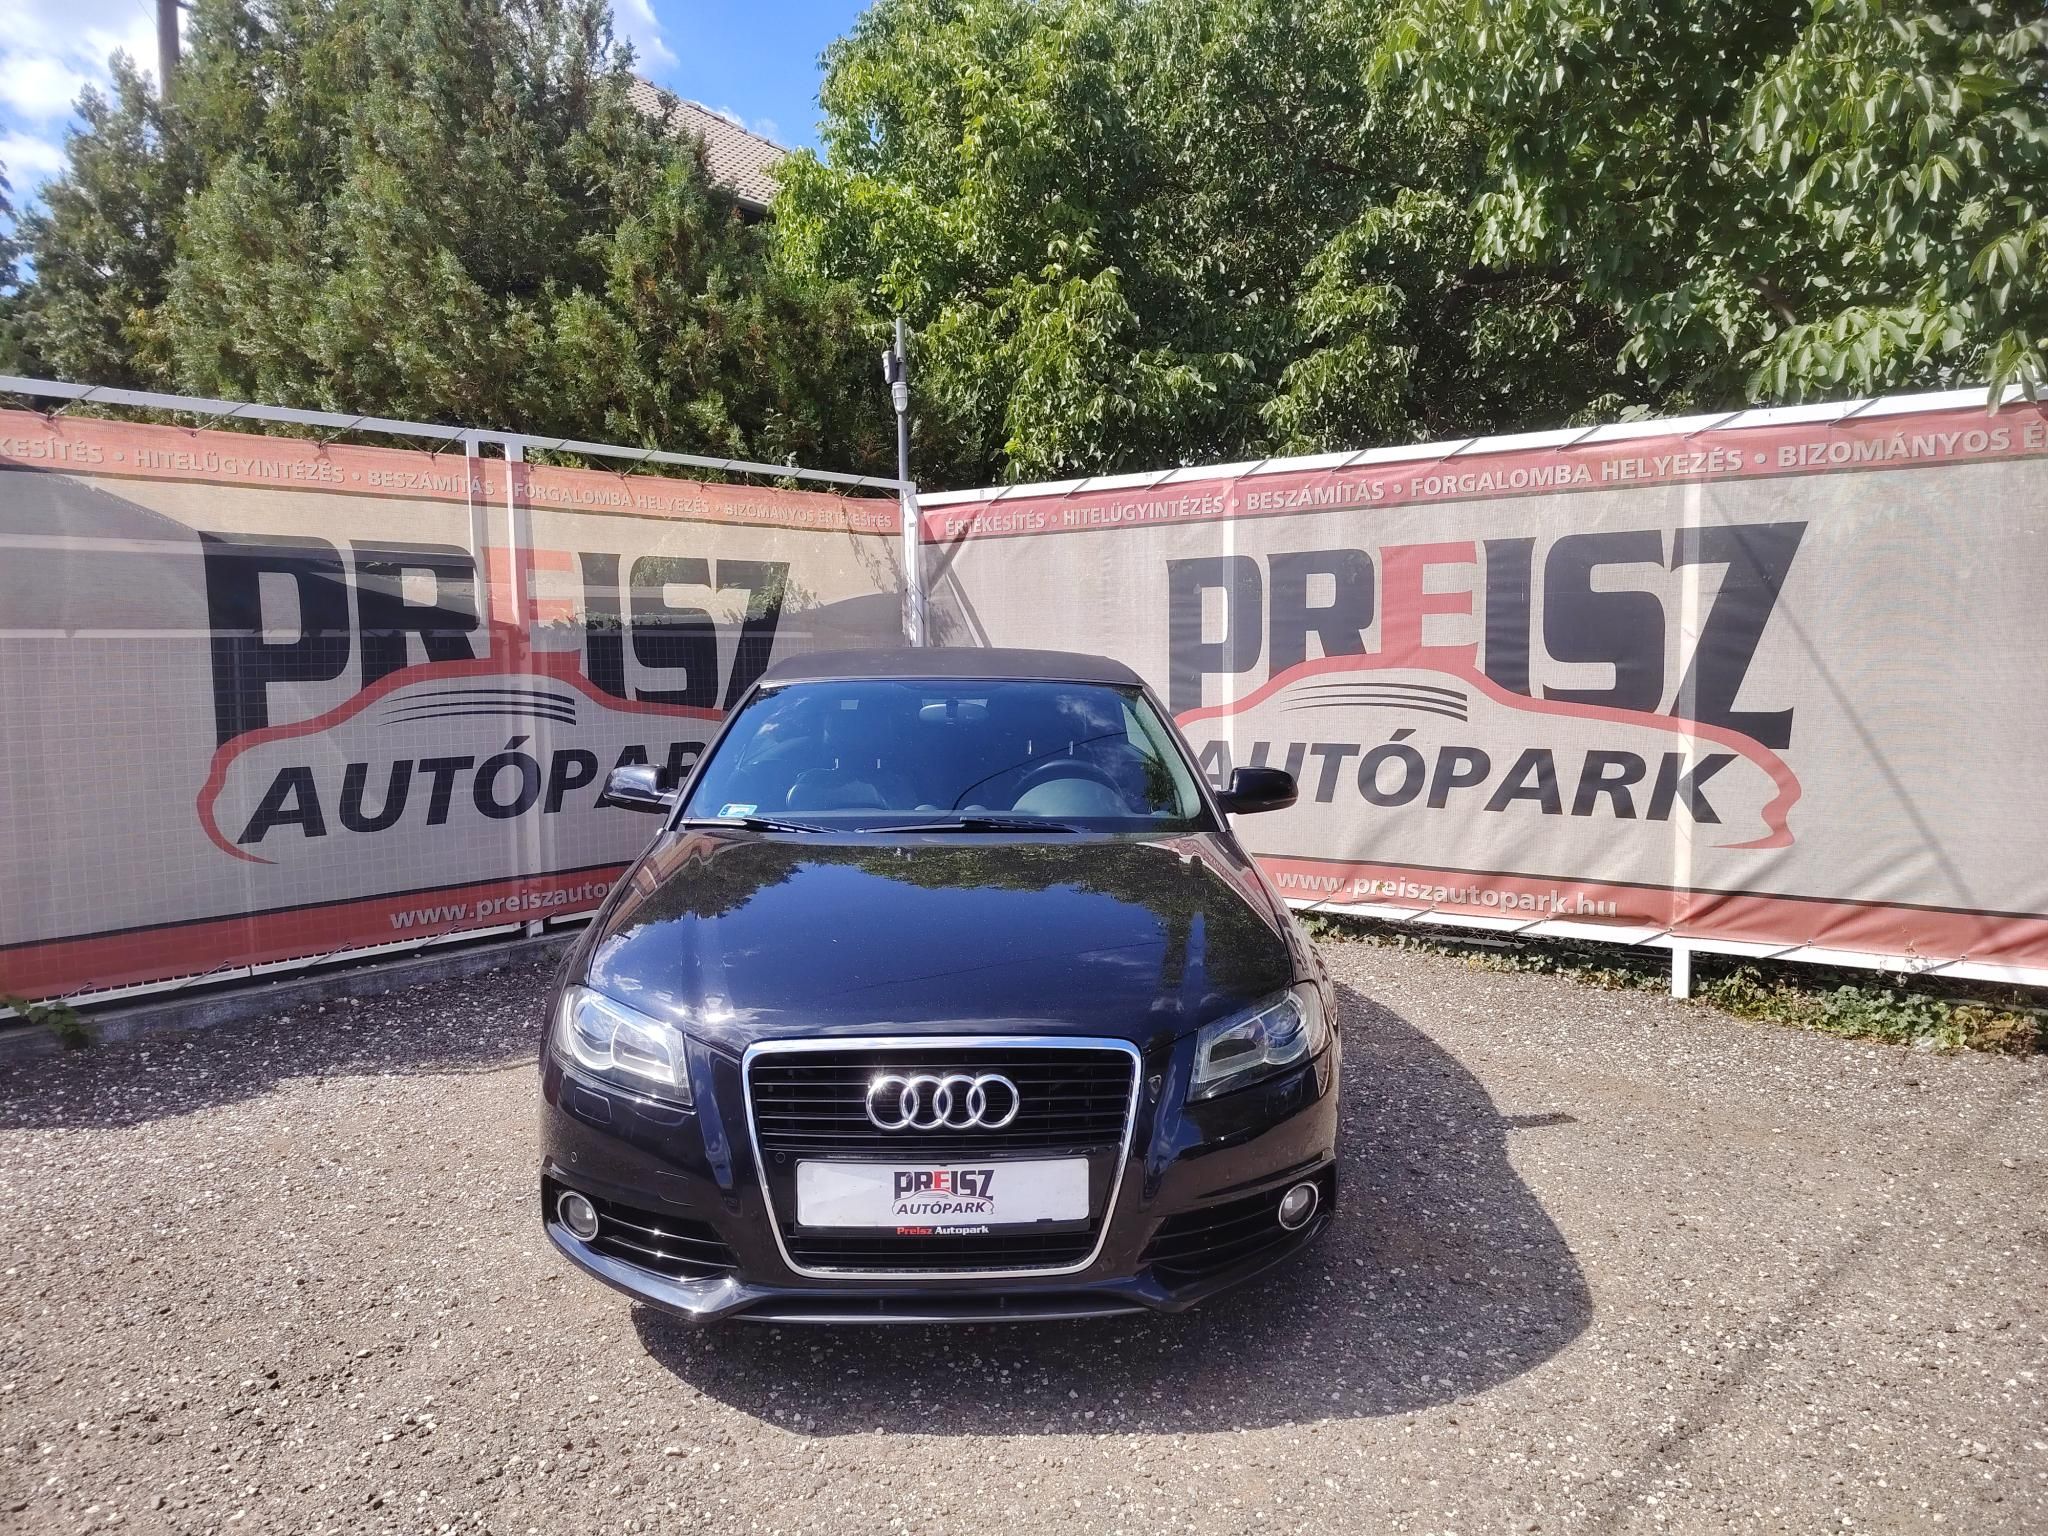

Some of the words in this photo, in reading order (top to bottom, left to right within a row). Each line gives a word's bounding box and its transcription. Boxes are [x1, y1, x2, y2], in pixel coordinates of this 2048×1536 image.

[134, 448, 345, 484] HITELÜGYINTÉZÉS
[368, 470, 495, 496] BESZÁMÍTÁS
[514, 482, 634, 507] FORGALOMBA
[637, 495, 710, 514] HELYEZÉS
[724, 503, 814, 522] BIZOMÁNYOS
[945, 511, 1046, 537] ÉRTÉKESÍTÉS
[1063, 494, 1225, 526] HITELÜGYINTÉZÉS
[1247, 480, 1385, 511] BESZÁMÍTÁS
[1411, 463, 1593, 497] FORGALOMBA
[1601, 446, 1744, 481] HELYEZÉS
[1777, 426, 2012, 468] BIZOMÁNYOS
[200, 531, 790, 747] PREISZ
[1166, 521, 1808, 749] PREISZ
[237, 735, 707, 844] AUTÓPAR
[1275, 870, 1618, 918] www.preiszautopark.hu
[894, 1169, 995, 1201] PREISZ
[896, 1200, 987, 1215] AUTÓPARK
[896, 1226, 933, 1236] Preisz
[934, 1225, 989, 1236] Autopark
